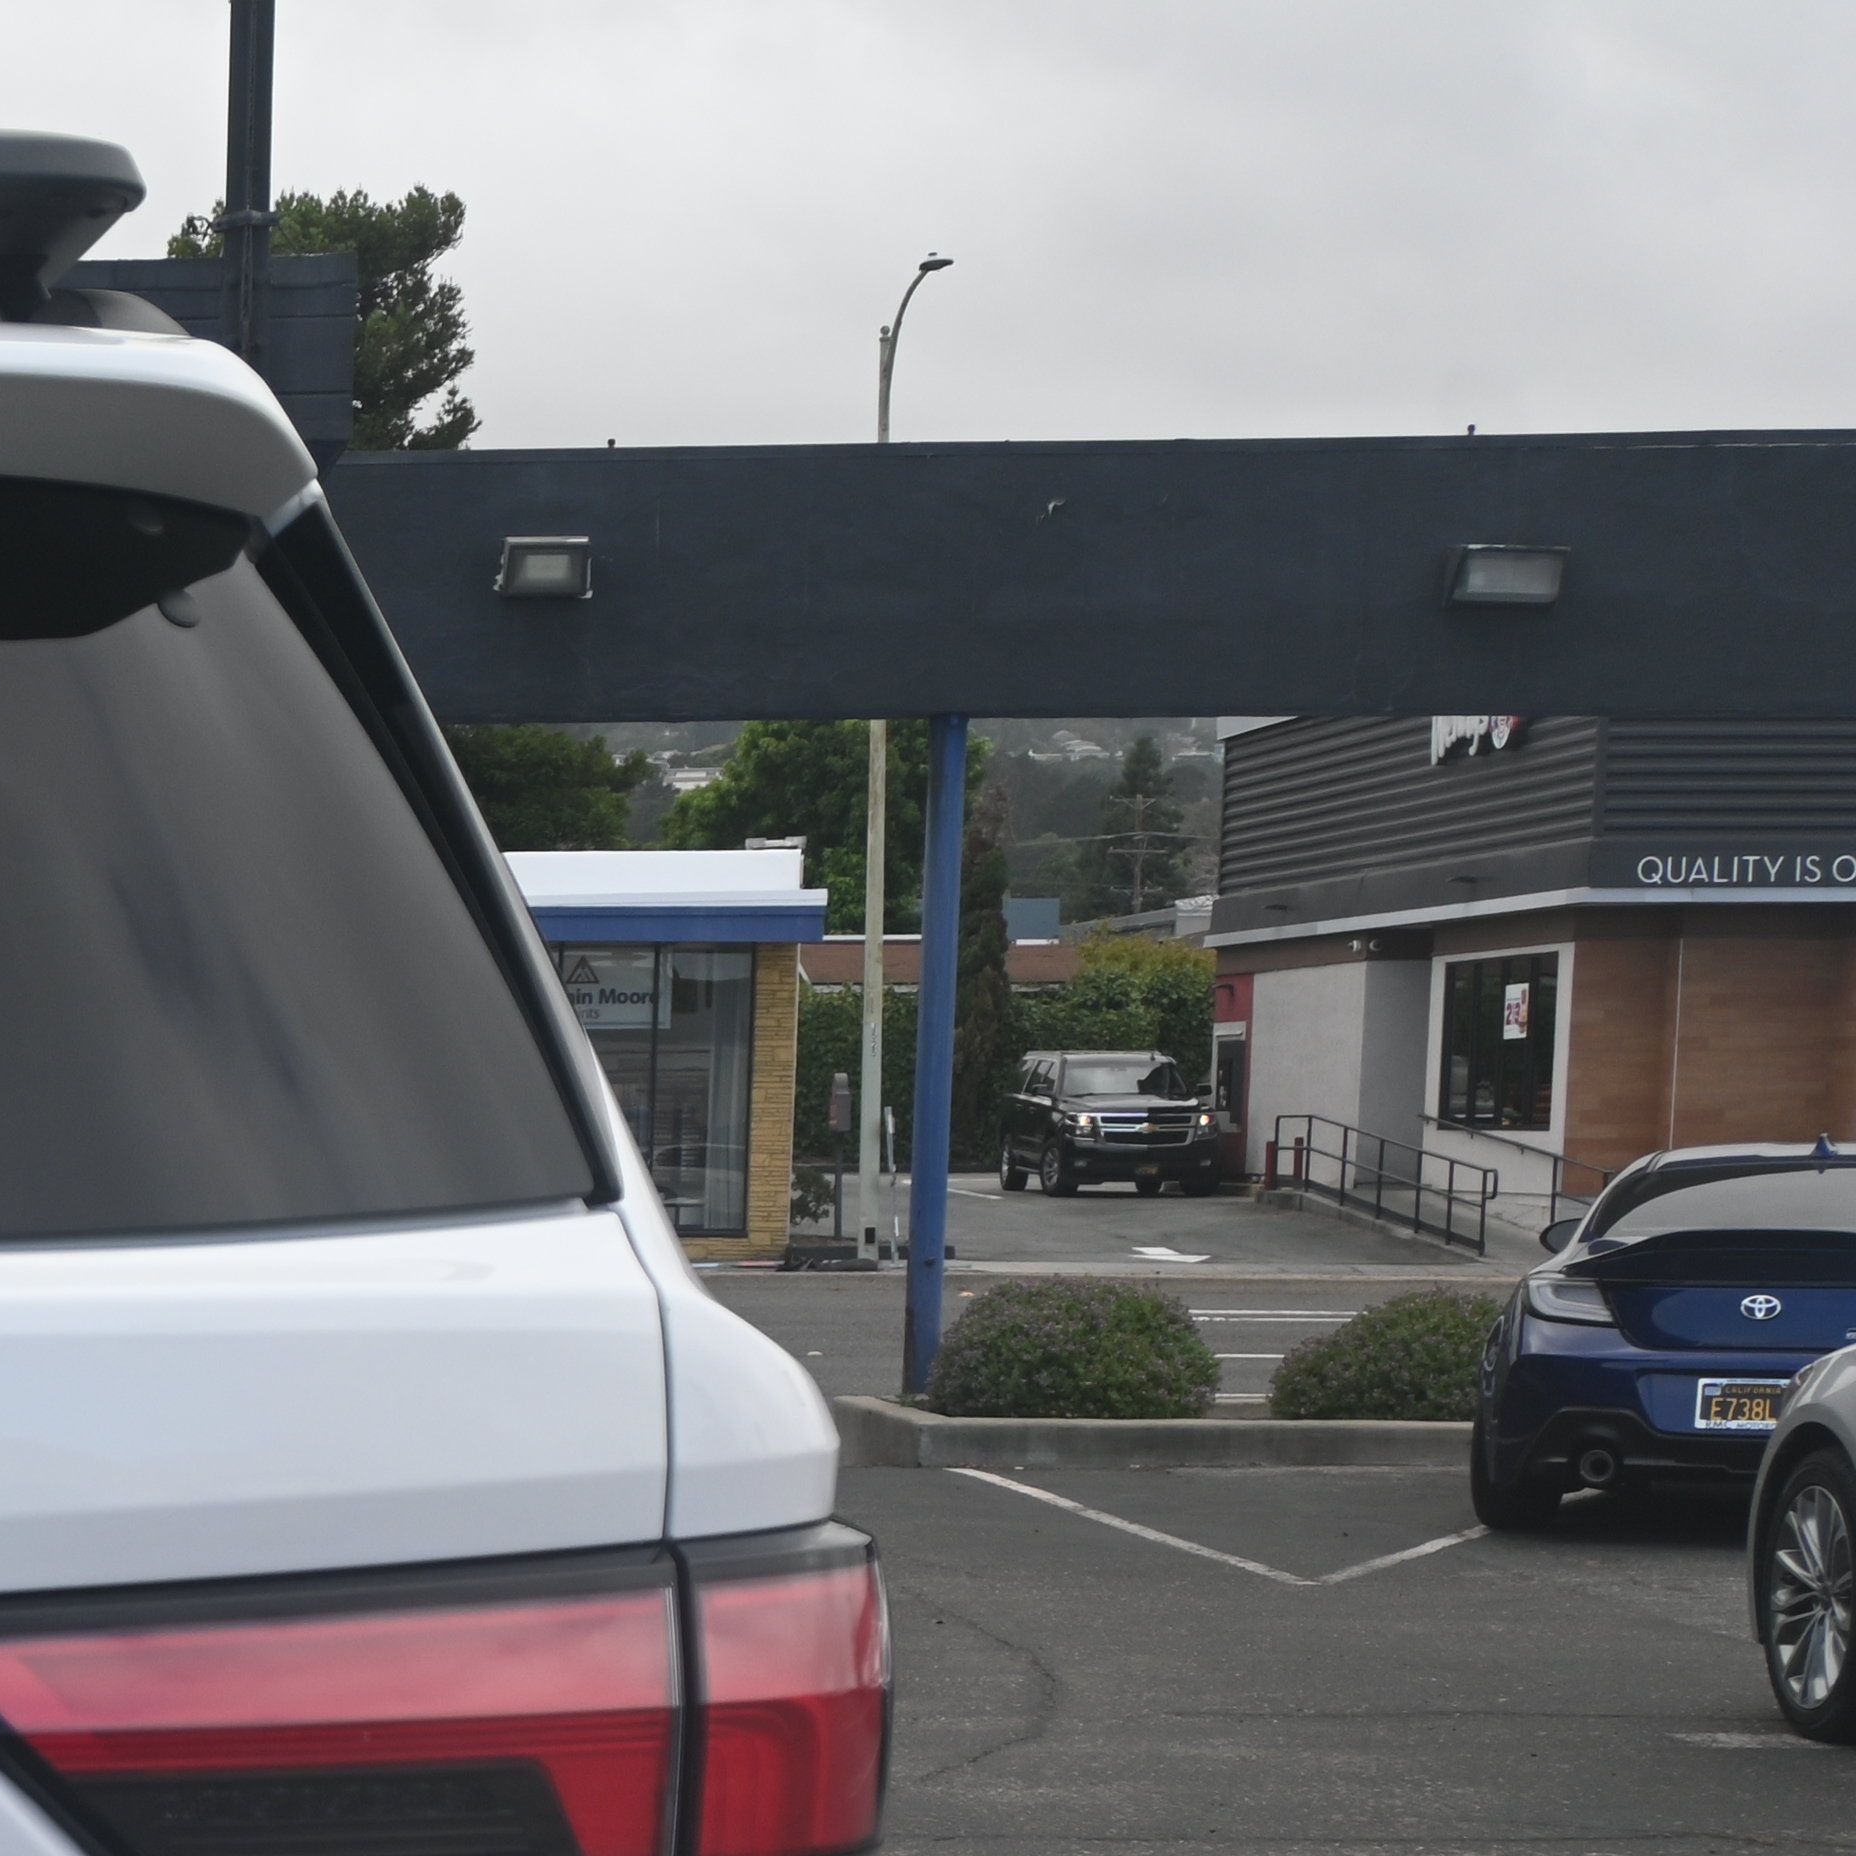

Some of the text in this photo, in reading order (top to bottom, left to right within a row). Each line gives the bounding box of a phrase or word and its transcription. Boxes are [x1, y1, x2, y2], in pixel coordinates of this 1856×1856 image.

[1637, 855, 1784, 884] QUALITY
[1795, 855, 1821, 882] IS
[1725, 1386, 1782, 1394] CALIFORNIA
